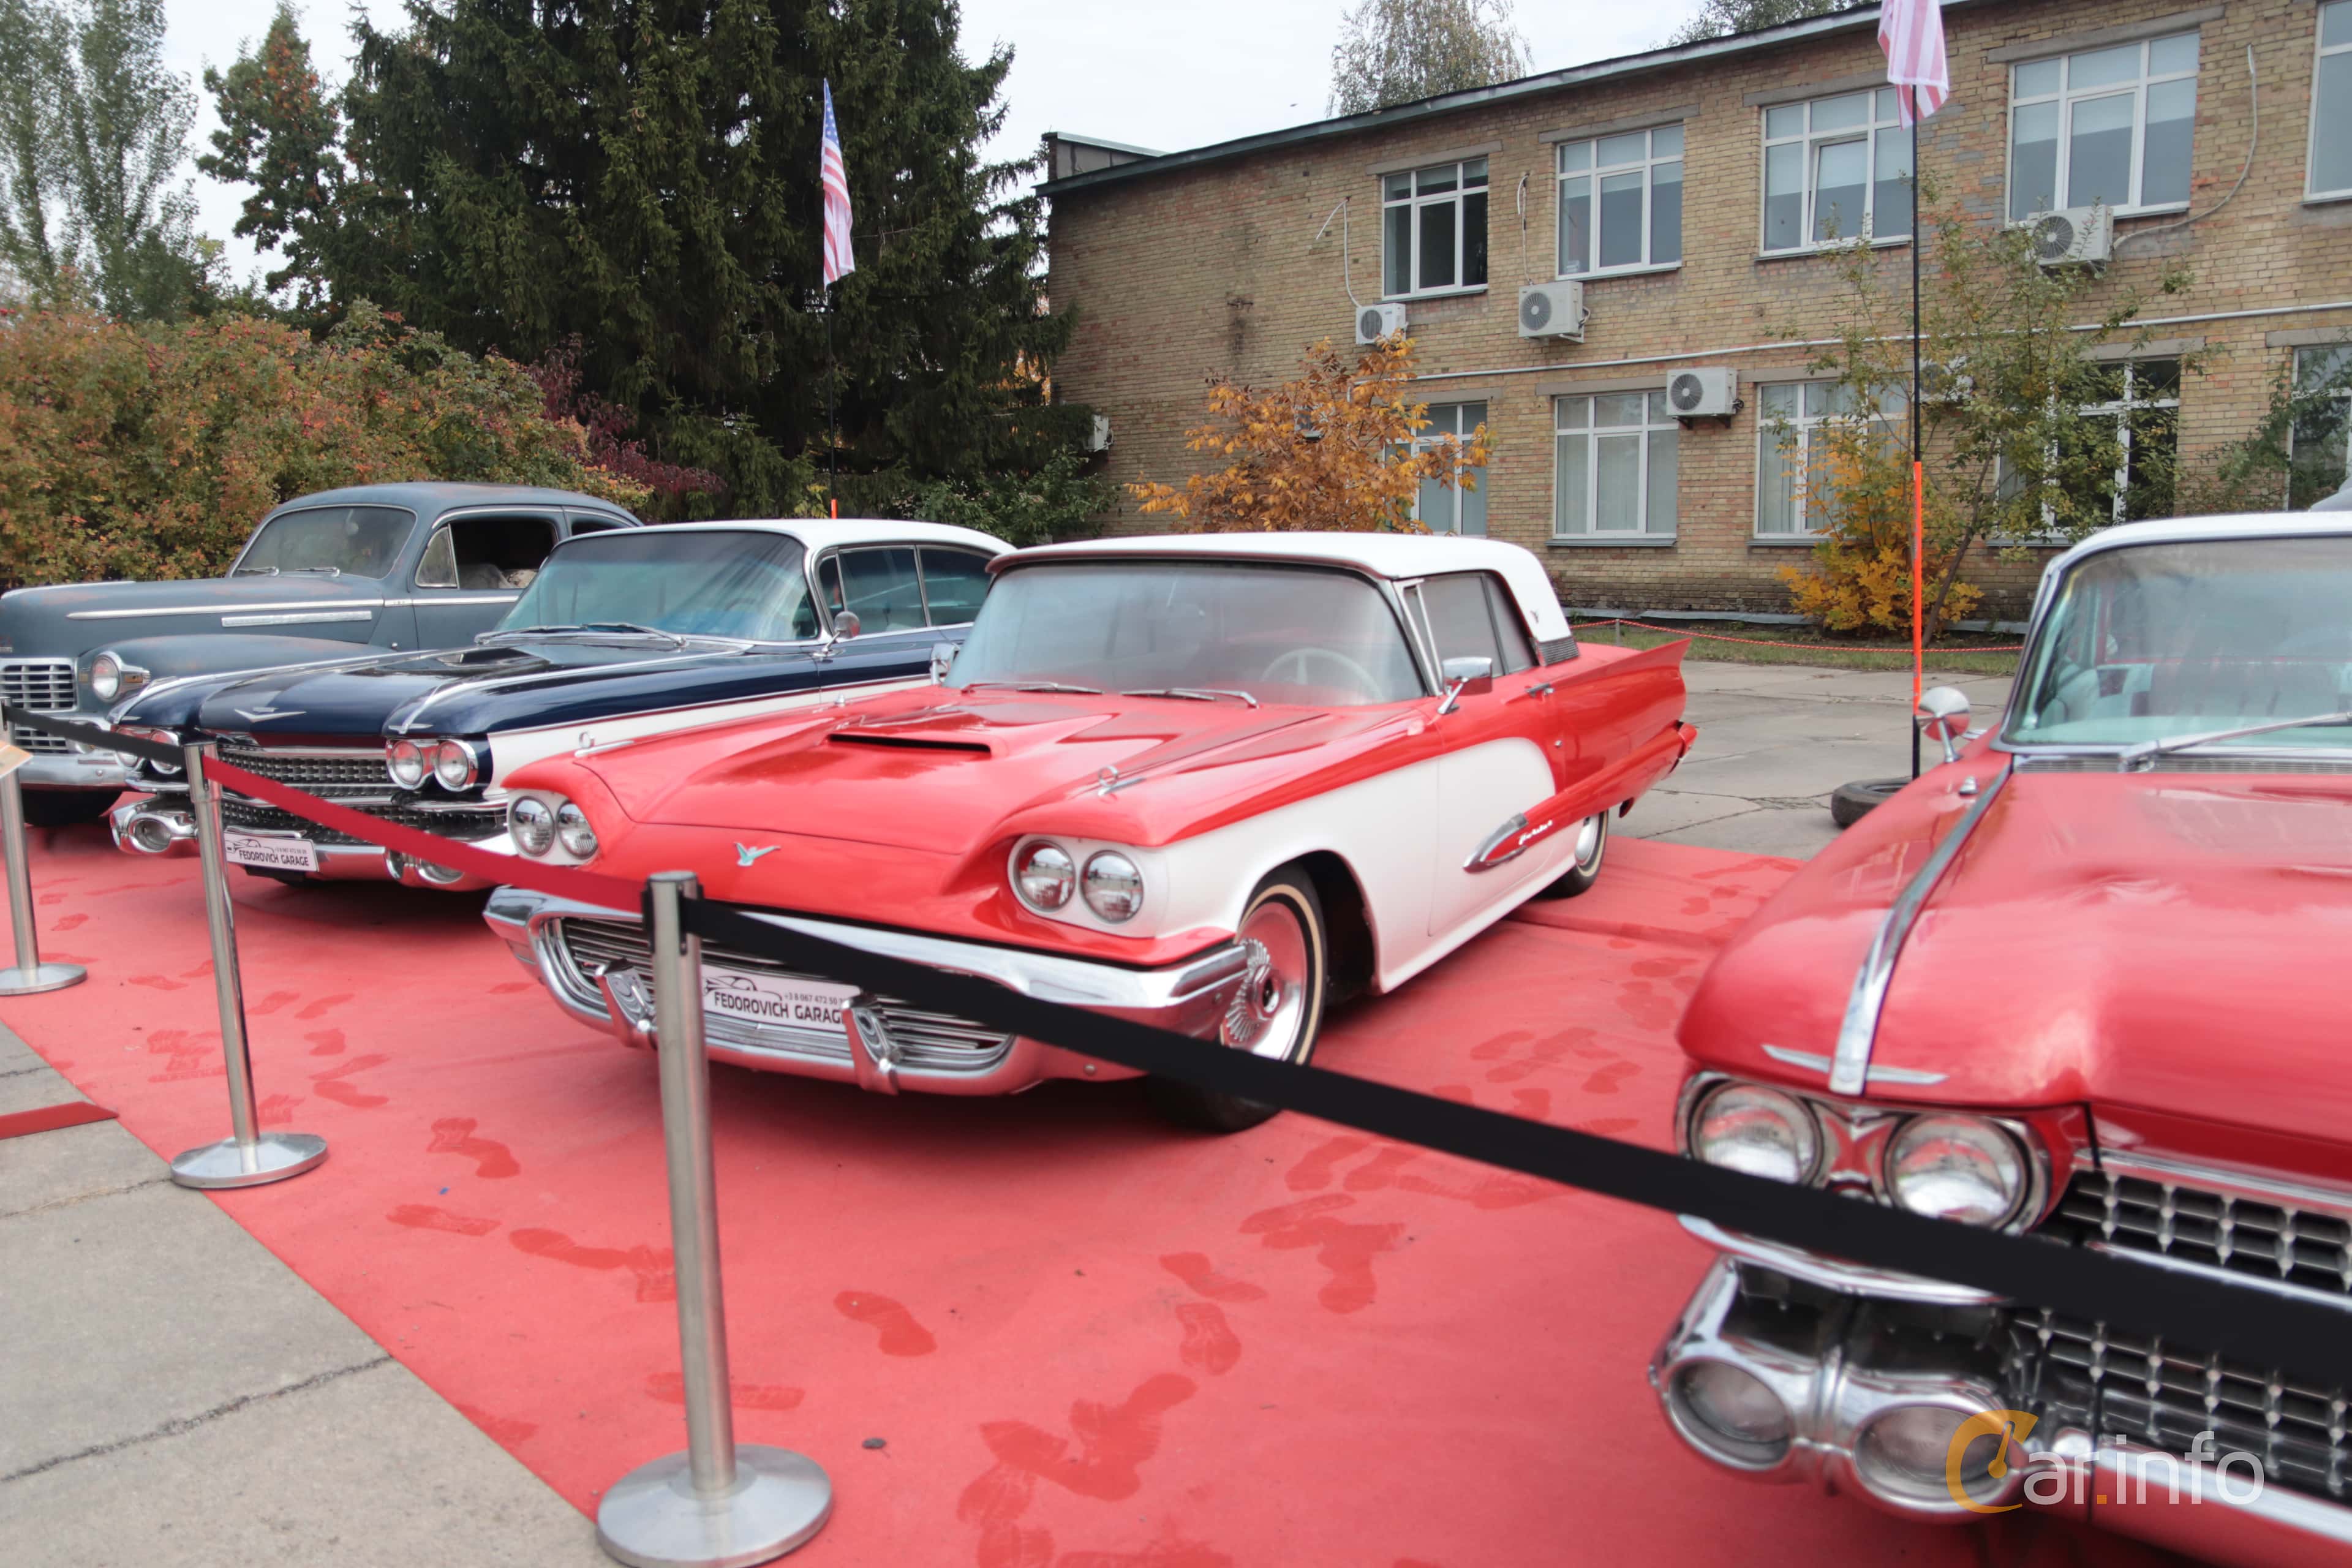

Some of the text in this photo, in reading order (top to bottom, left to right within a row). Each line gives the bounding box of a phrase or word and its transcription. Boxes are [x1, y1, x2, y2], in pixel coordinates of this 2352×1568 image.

[239, 850, 279, 864] FEDOROVICH
[281, 854, 309, 866] GARAGE
[715, 992, 844, 1025] FEDOROVICH GARAG
